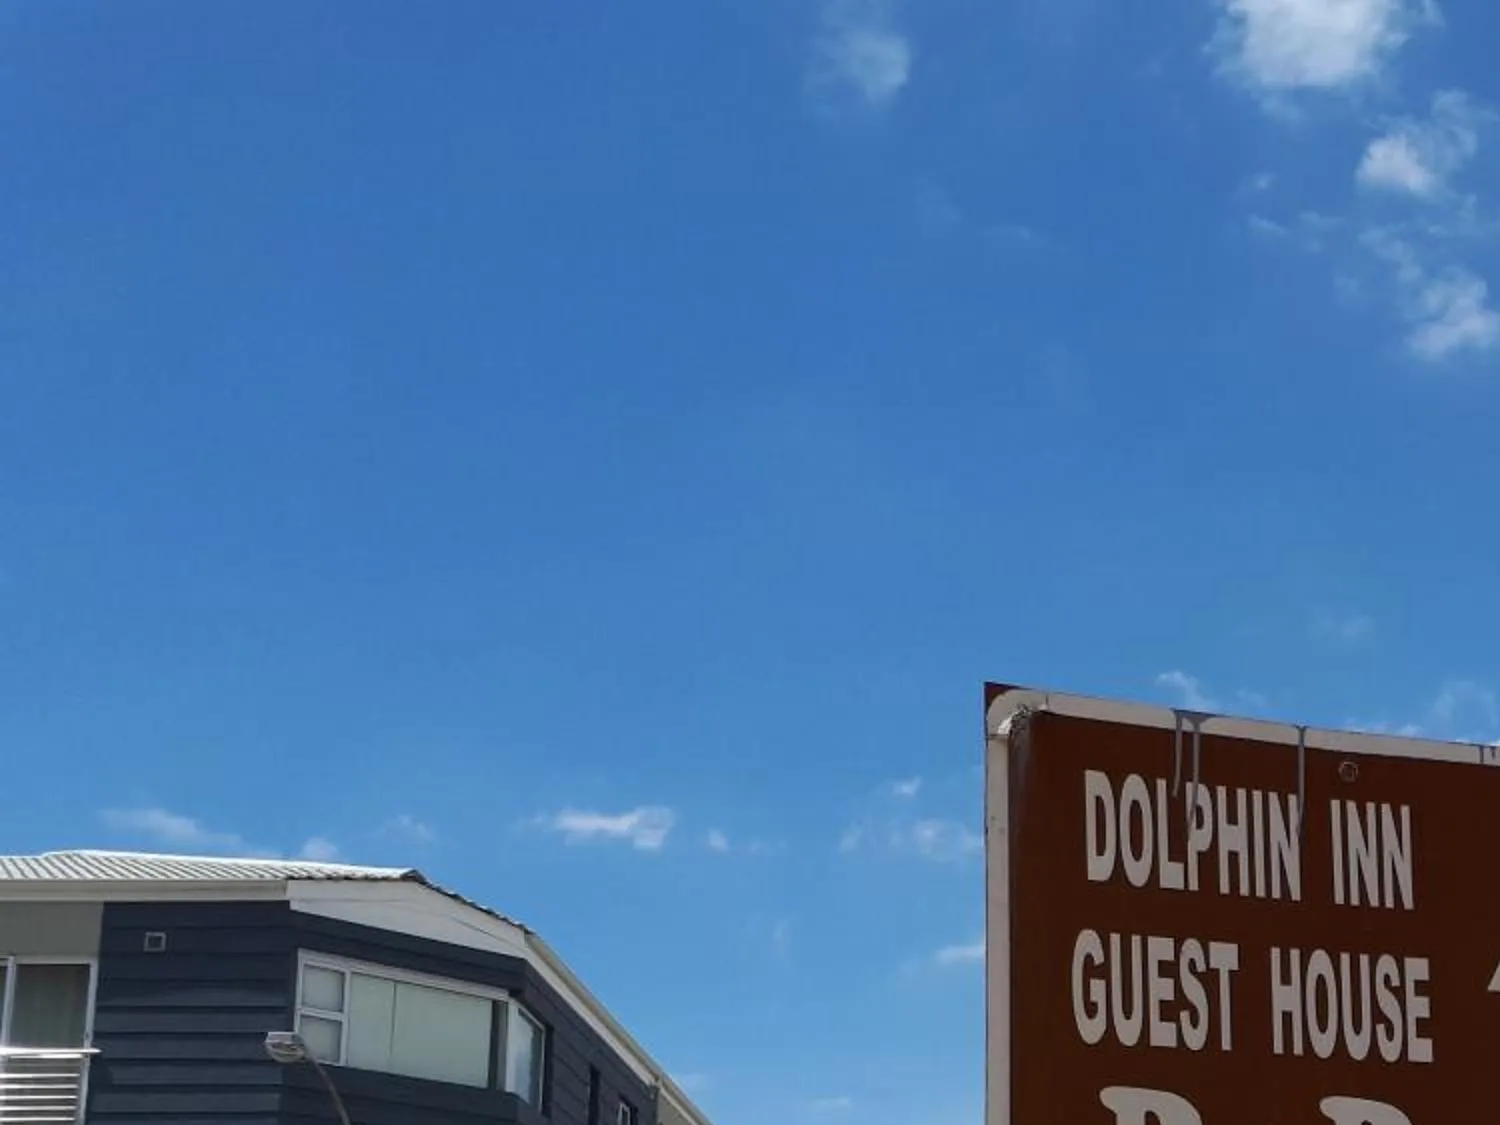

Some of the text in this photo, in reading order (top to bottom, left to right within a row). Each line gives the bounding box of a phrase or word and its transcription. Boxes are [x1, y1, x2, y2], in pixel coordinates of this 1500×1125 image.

[1084, 769, 1415, 909] DOLPHIN INN
[1072, 929, 1434, 1063] GUEST HOUSE
